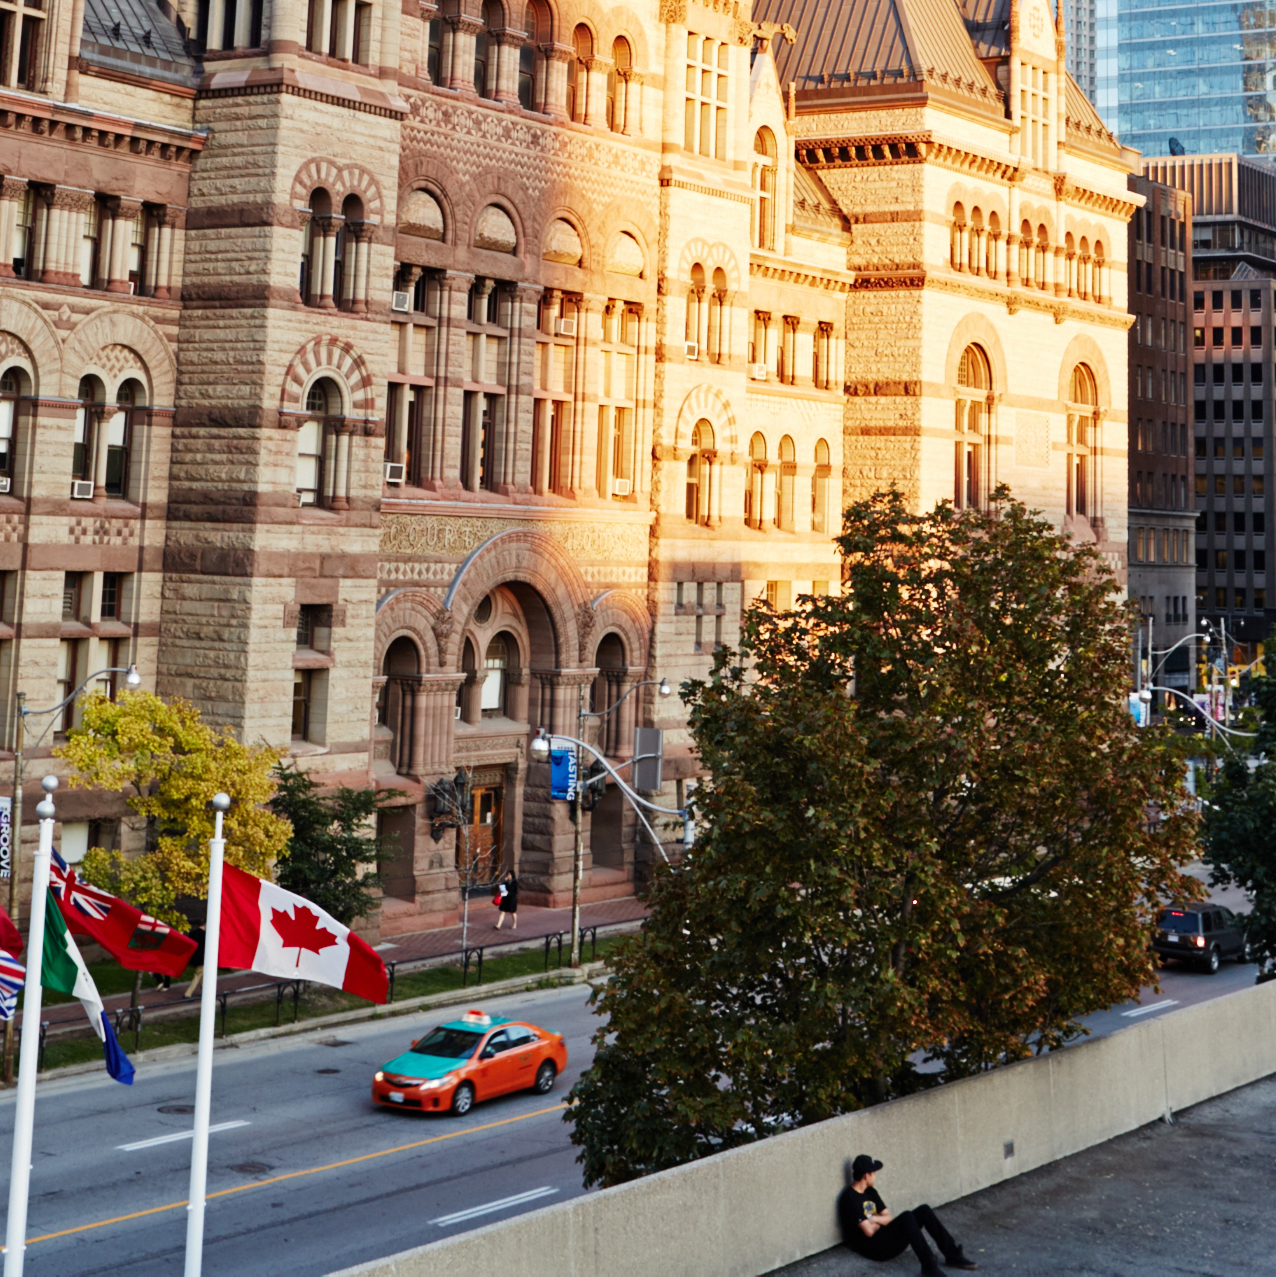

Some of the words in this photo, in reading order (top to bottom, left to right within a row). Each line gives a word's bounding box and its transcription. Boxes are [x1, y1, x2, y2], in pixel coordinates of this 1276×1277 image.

[389, 523, 474, 547] COURT
[566, 751, 577, 801] TASTING
[0, 812, 11, 878] GROOVE
